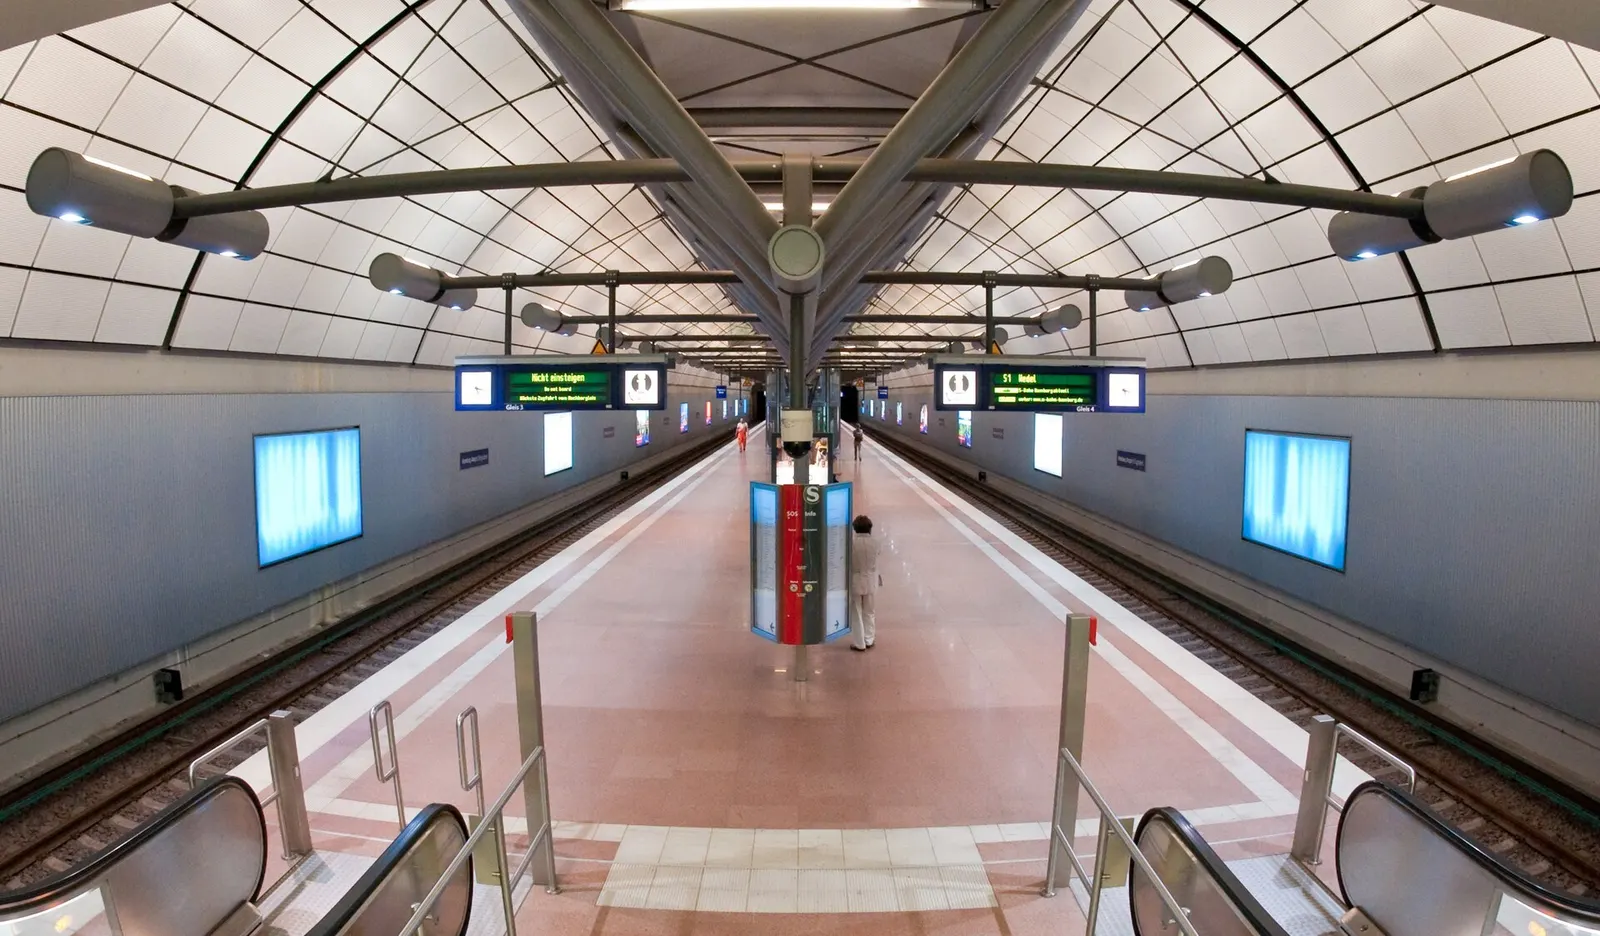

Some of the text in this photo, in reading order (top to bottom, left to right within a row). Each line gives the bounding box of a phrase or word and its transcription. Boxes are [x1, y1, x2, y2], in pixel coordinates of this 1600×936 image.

[531, 373, 585, 383] Nicht einsteigen
[1003, 373, 1012, 383] S1
[806, 485, 820, 502] S
